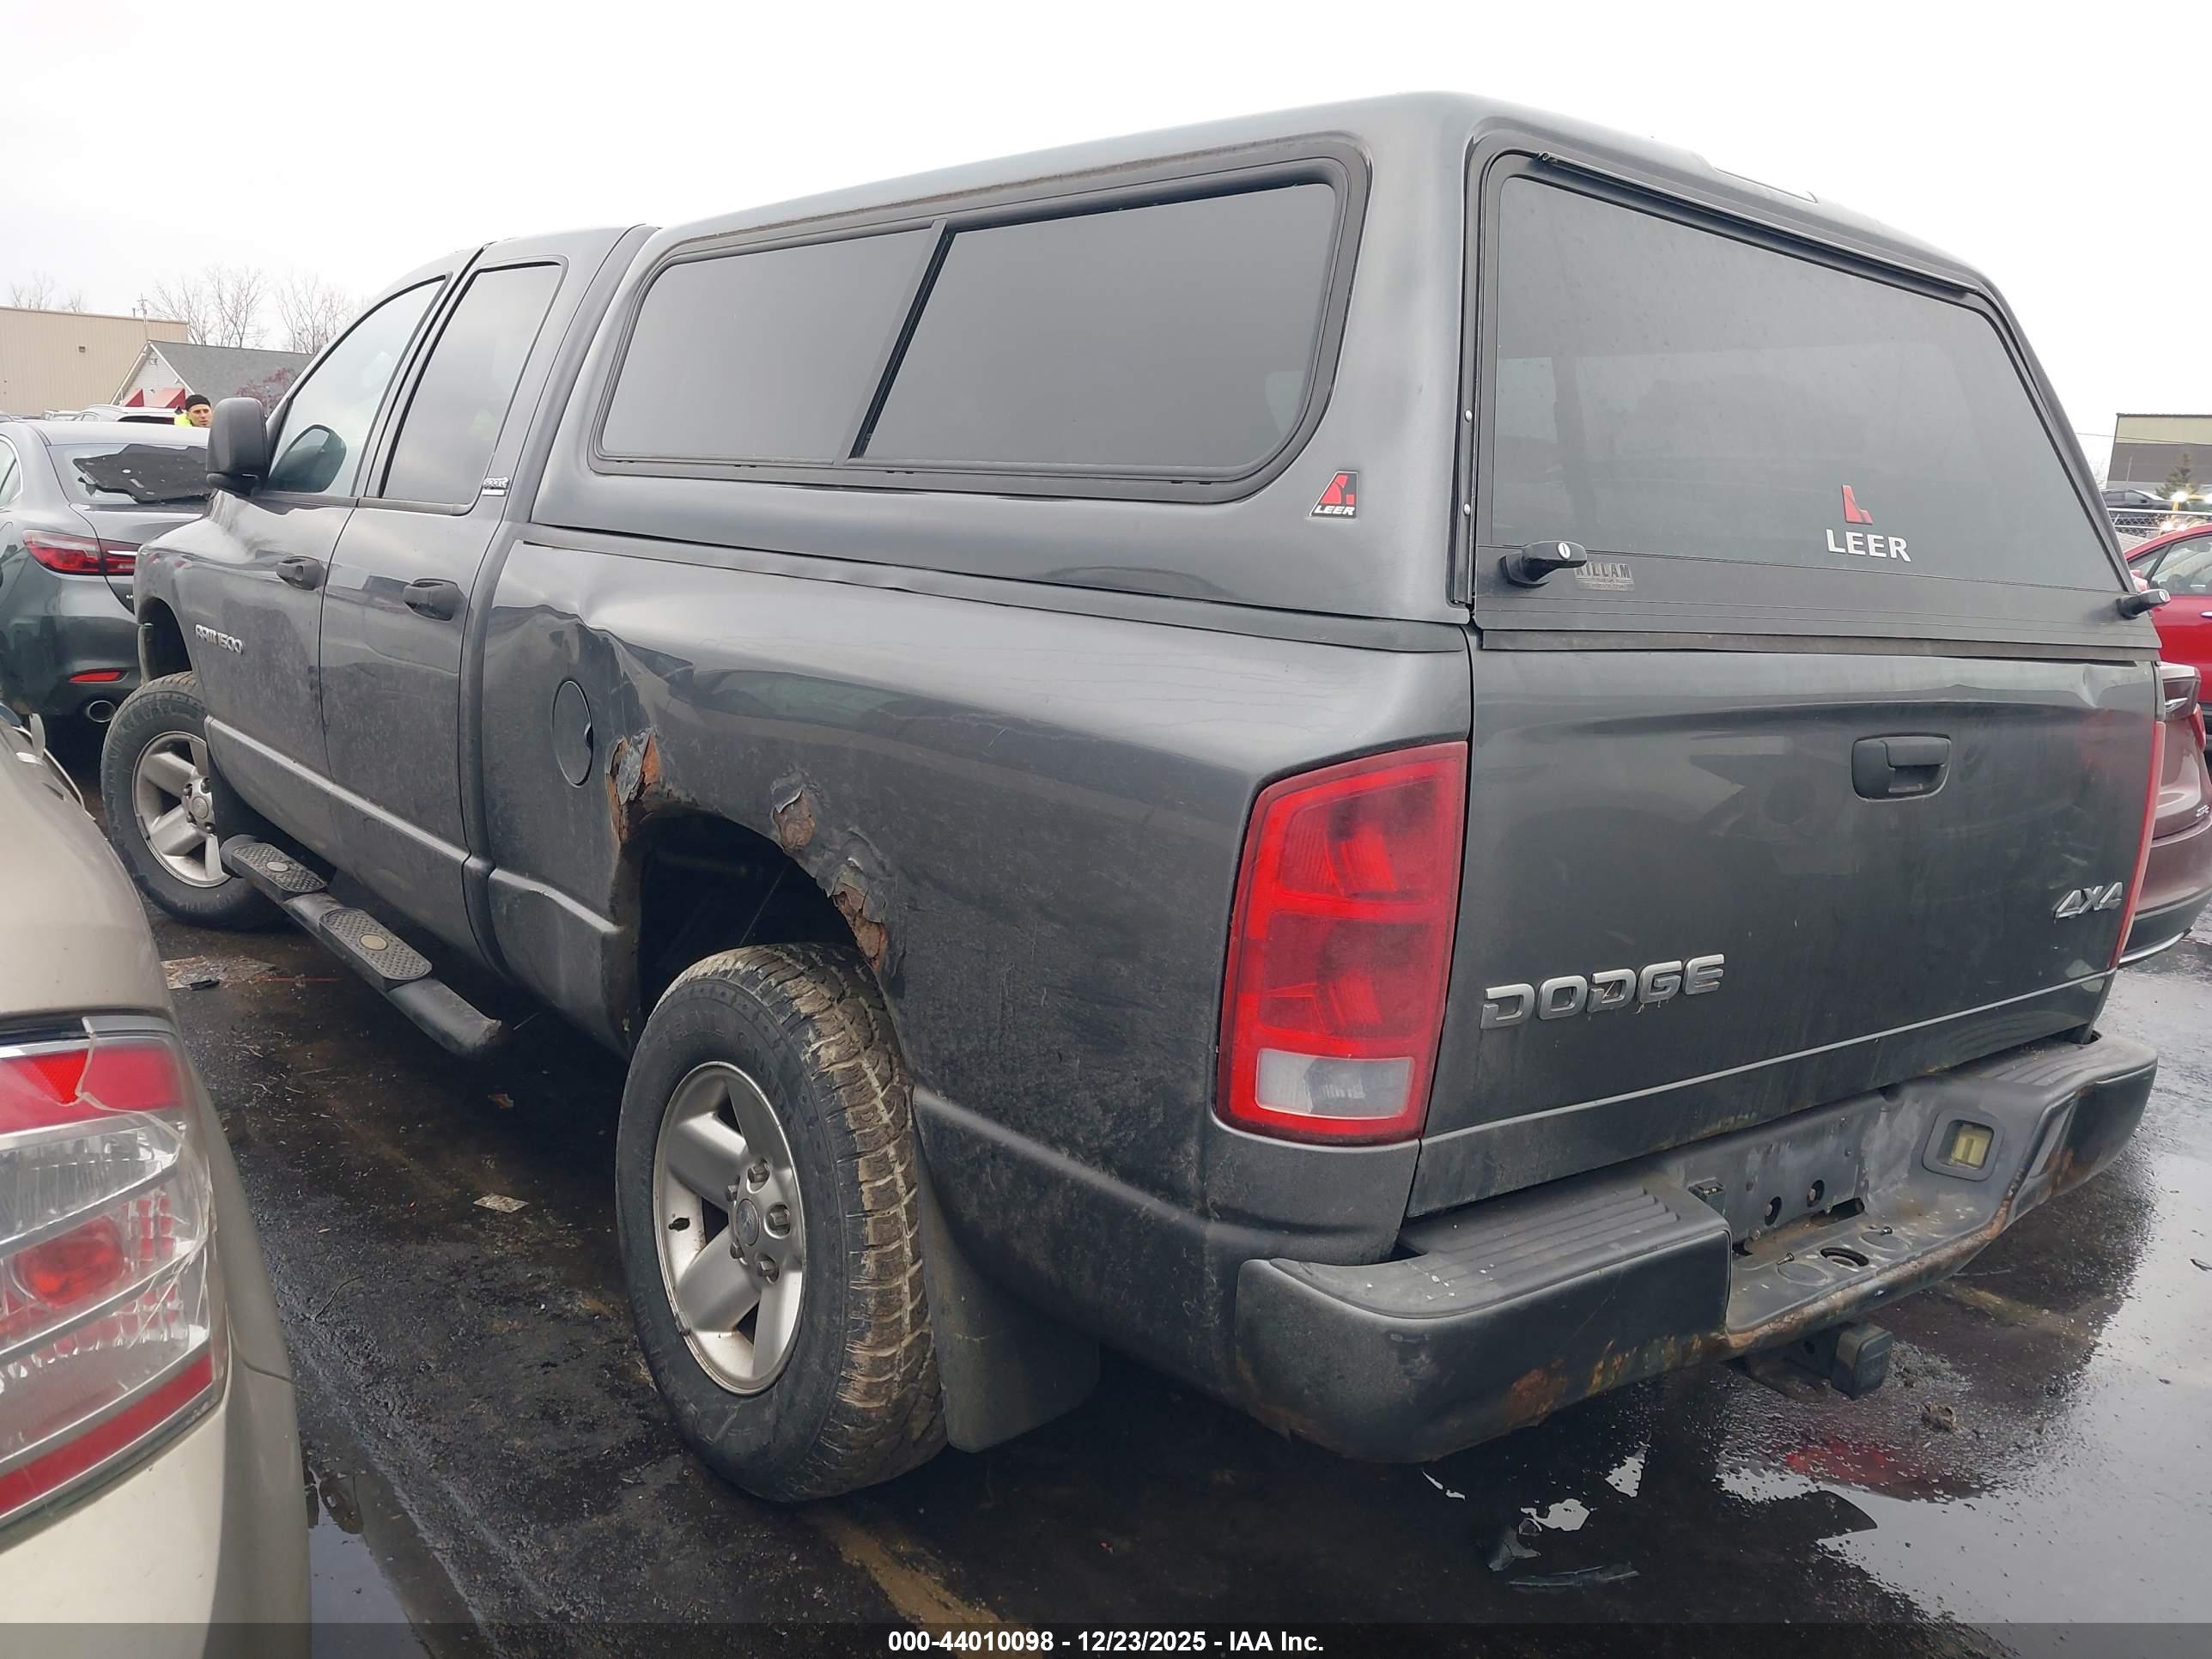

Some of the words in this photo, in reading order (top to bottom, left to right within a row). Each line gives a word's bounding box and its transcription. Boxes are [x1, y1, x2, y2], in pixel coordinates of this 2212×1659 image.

[1314, 505, 1356, 516] LEER
[1826, 528, 1912, 562] LEER
[1480, 953, 1725, 1030] DODGE
